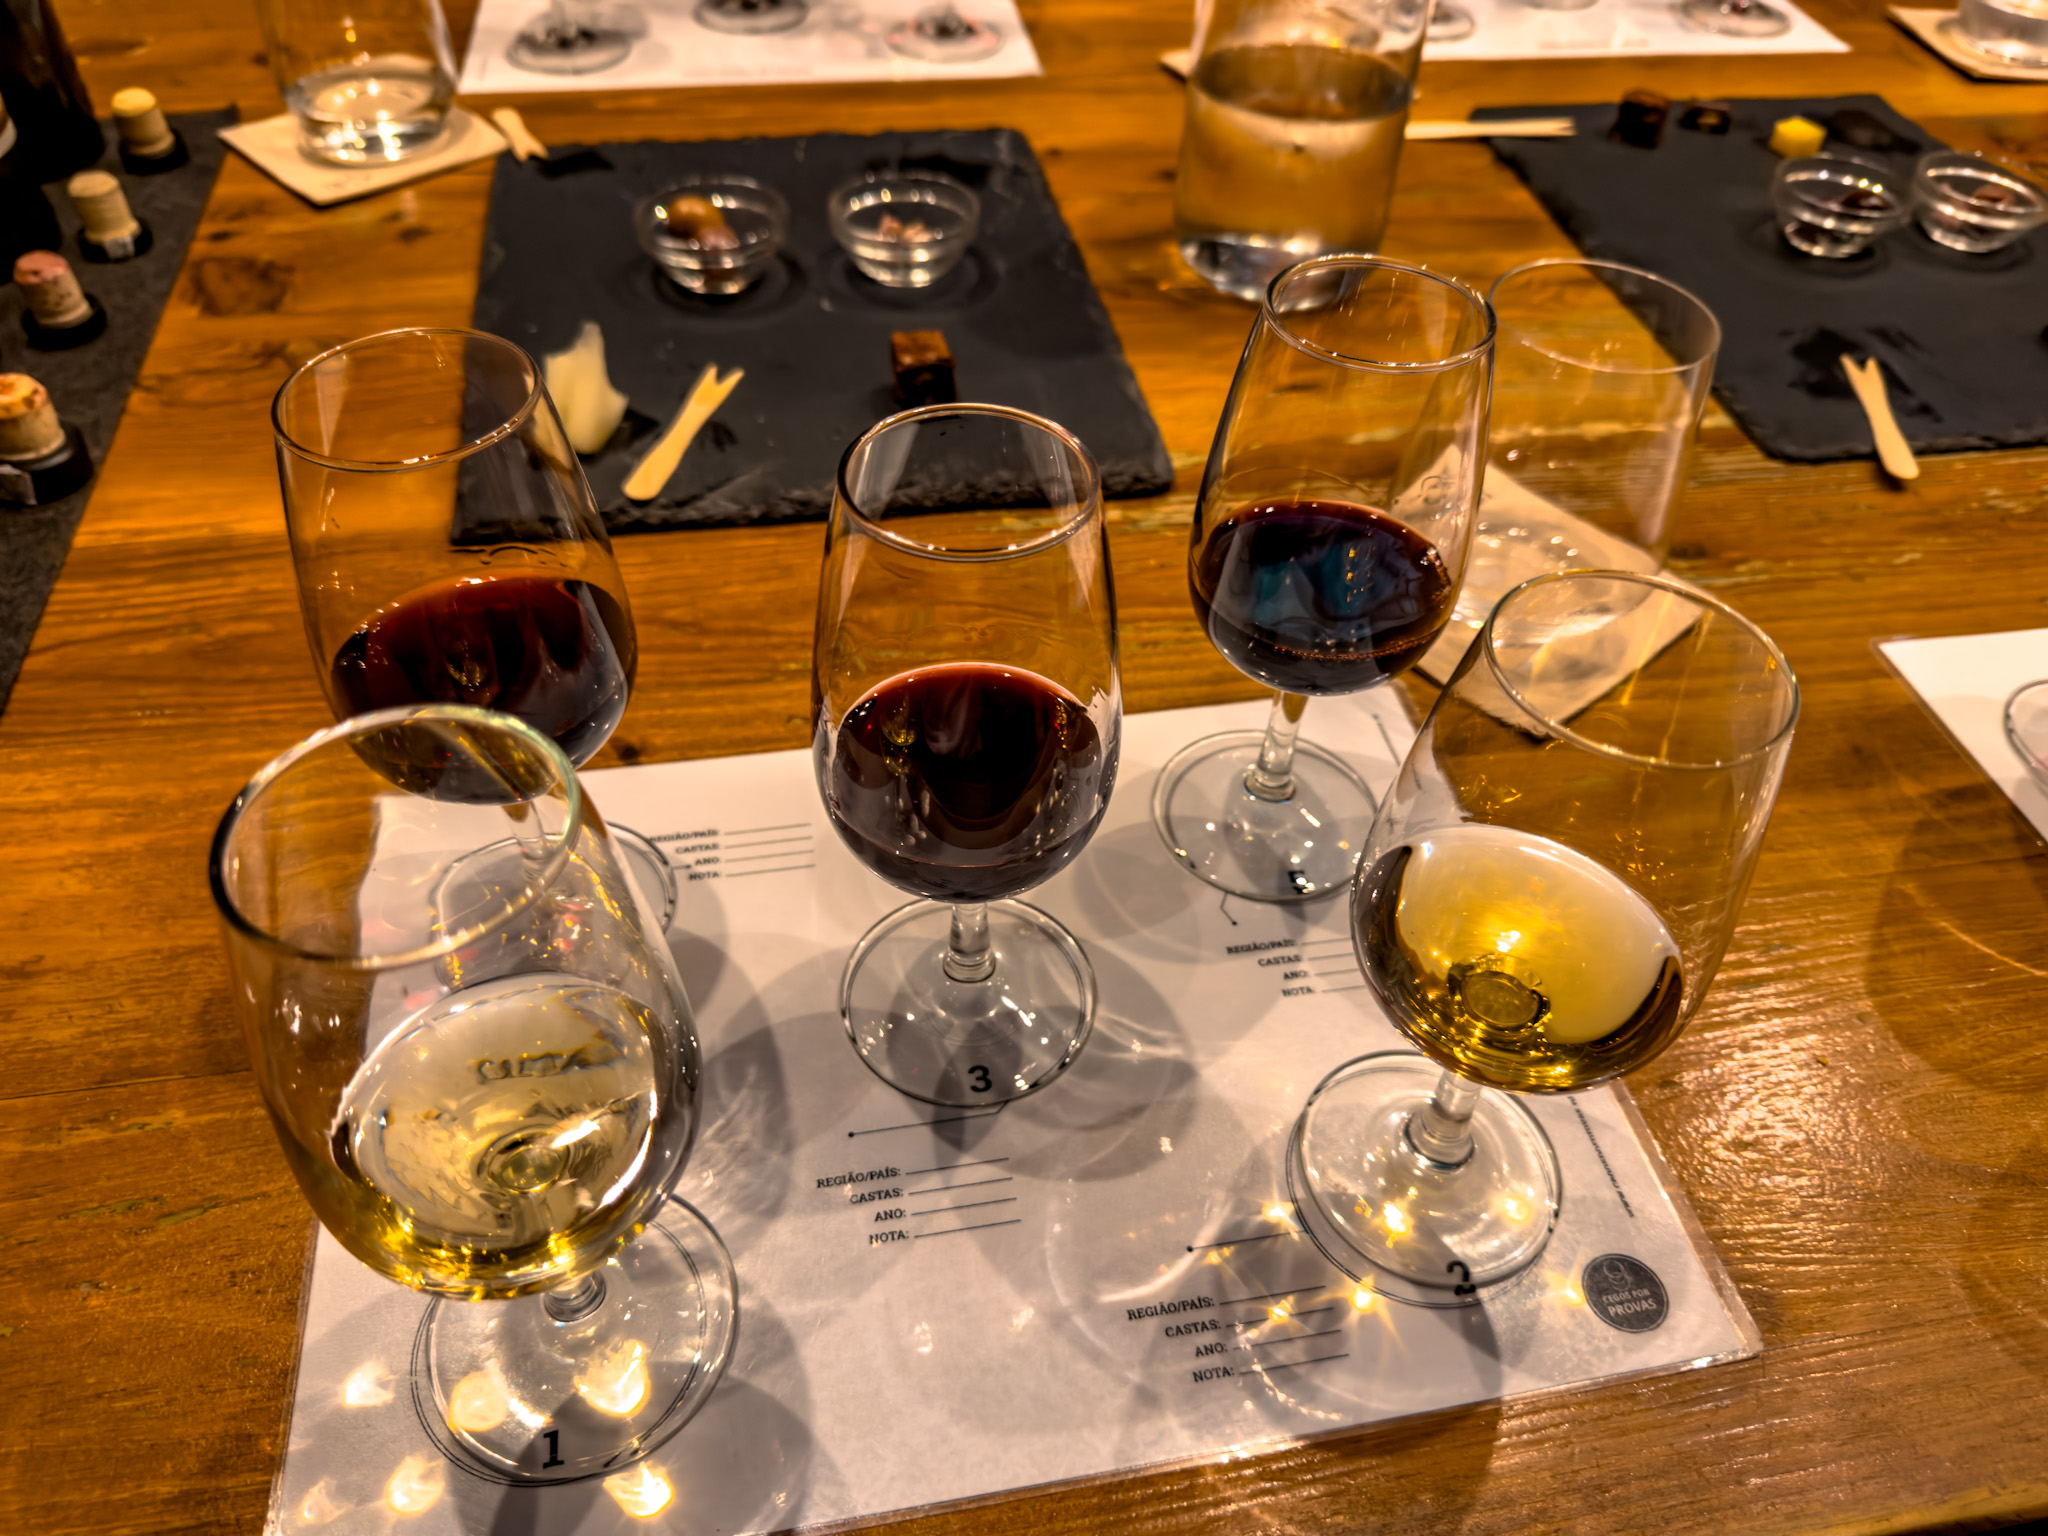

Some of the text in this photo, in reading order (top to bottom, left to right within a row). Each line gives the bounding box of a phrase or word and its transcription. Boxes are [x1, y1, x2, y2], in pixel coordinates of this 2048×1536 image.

[967, 1065, 993, 1093] 3
[816, 1166, 901, 1188] REGIÃO/PAÍS:
[849, 1187, 904, 1204] CASTAS:
[874, 1208, 907, 1222] ANO:
[868, 1229, 909, 1245] NOTA:
[1446, 1259, 1477, 1296] 2
[1602, 1288, 1651, 1304] CEGOS POR
[1127, 1296, 1215, 1321] REGIÃO/PAÍS:
[1607, 1298, 1657, 1317] PROVAS
[1165, 1319, 1222, 1338] CASTAS:
[1195, 1342, 1228, 1358] ANO:
[1192, 1366, 1235, 1383] NOTA:
[542, 1430, 565, 1469] 1
